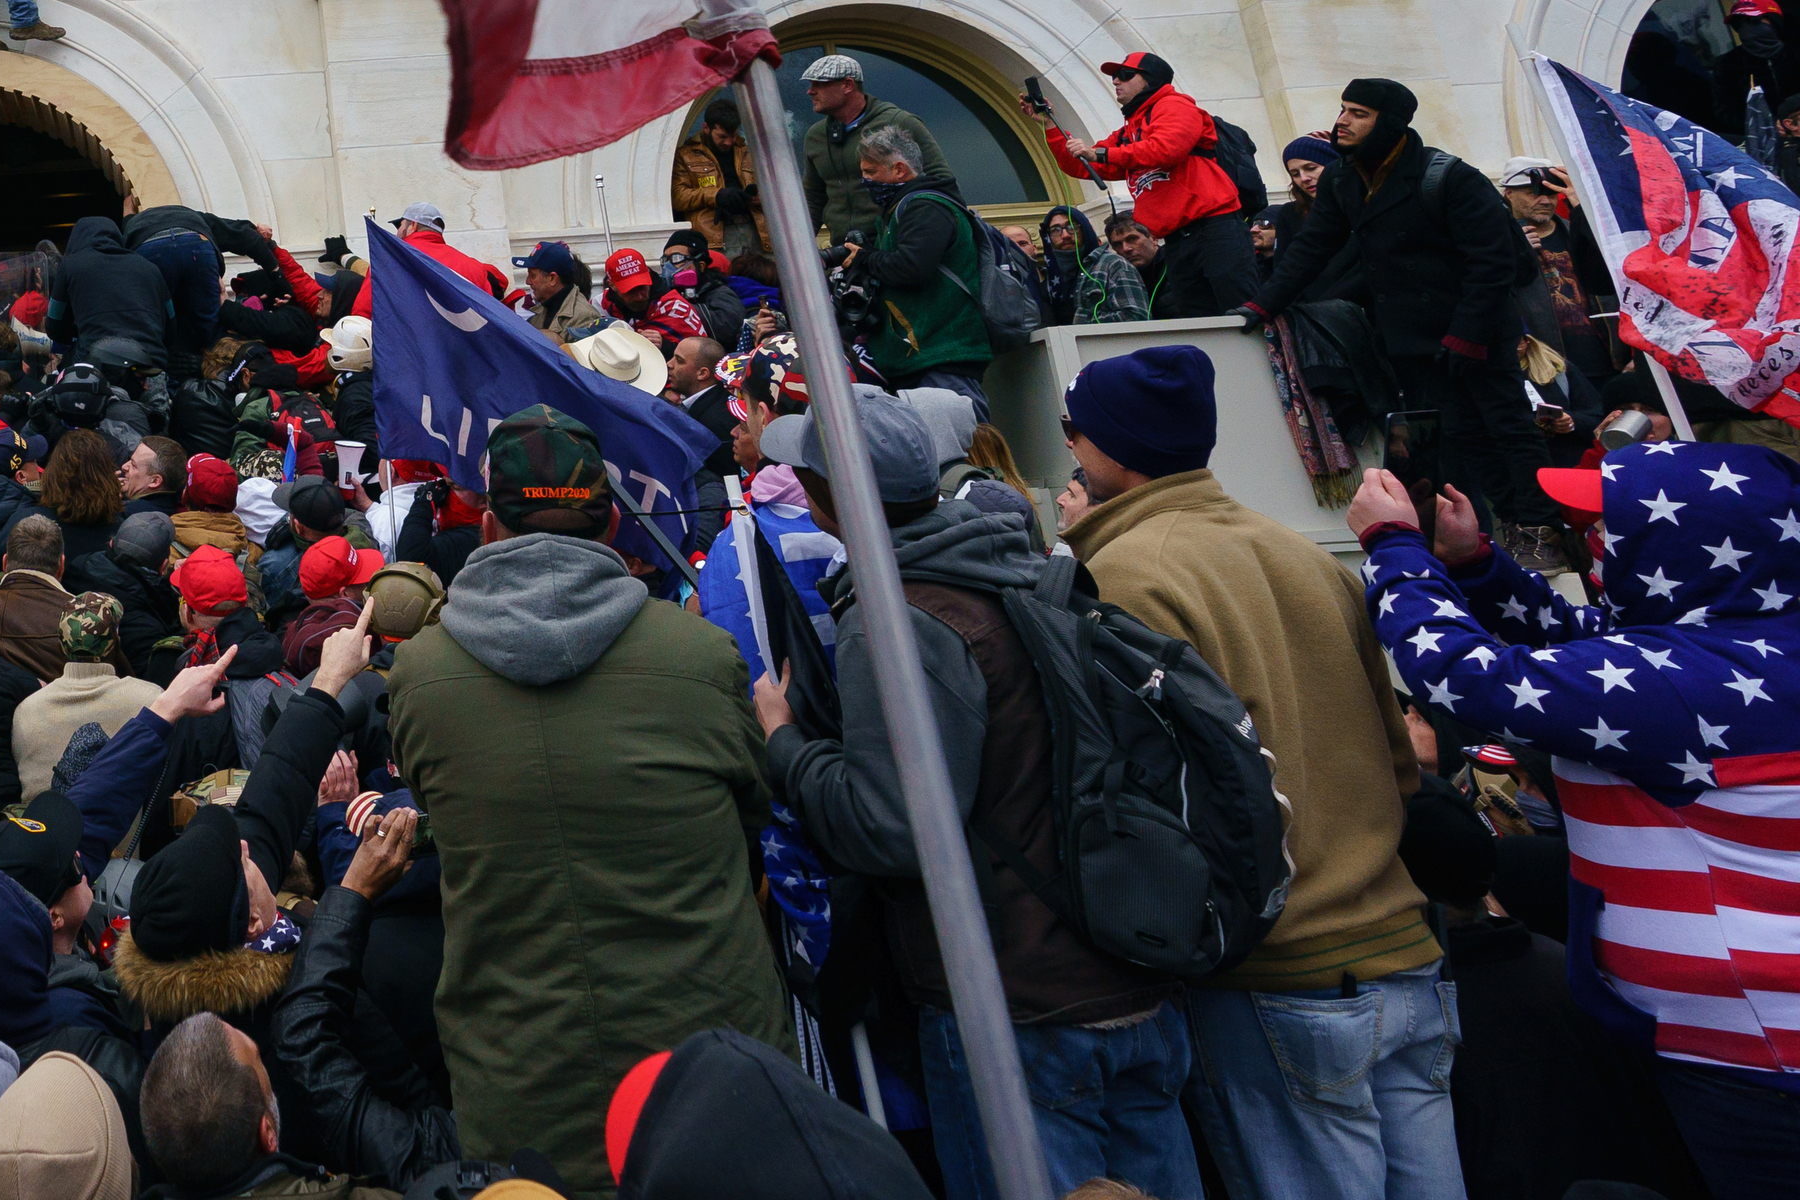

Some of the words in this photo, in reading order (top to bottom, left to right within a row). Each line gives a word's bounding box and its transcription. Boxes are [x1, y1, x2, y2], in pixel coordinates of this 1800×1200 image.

[615, 259, 641, 273] AMERICA
[617, 255, 633, 265] KEEP
[620, 265, 640, 277] GREAT
[10, 454, 22, 470] 45
[522, 487, 590, 499] TRUMP2020
